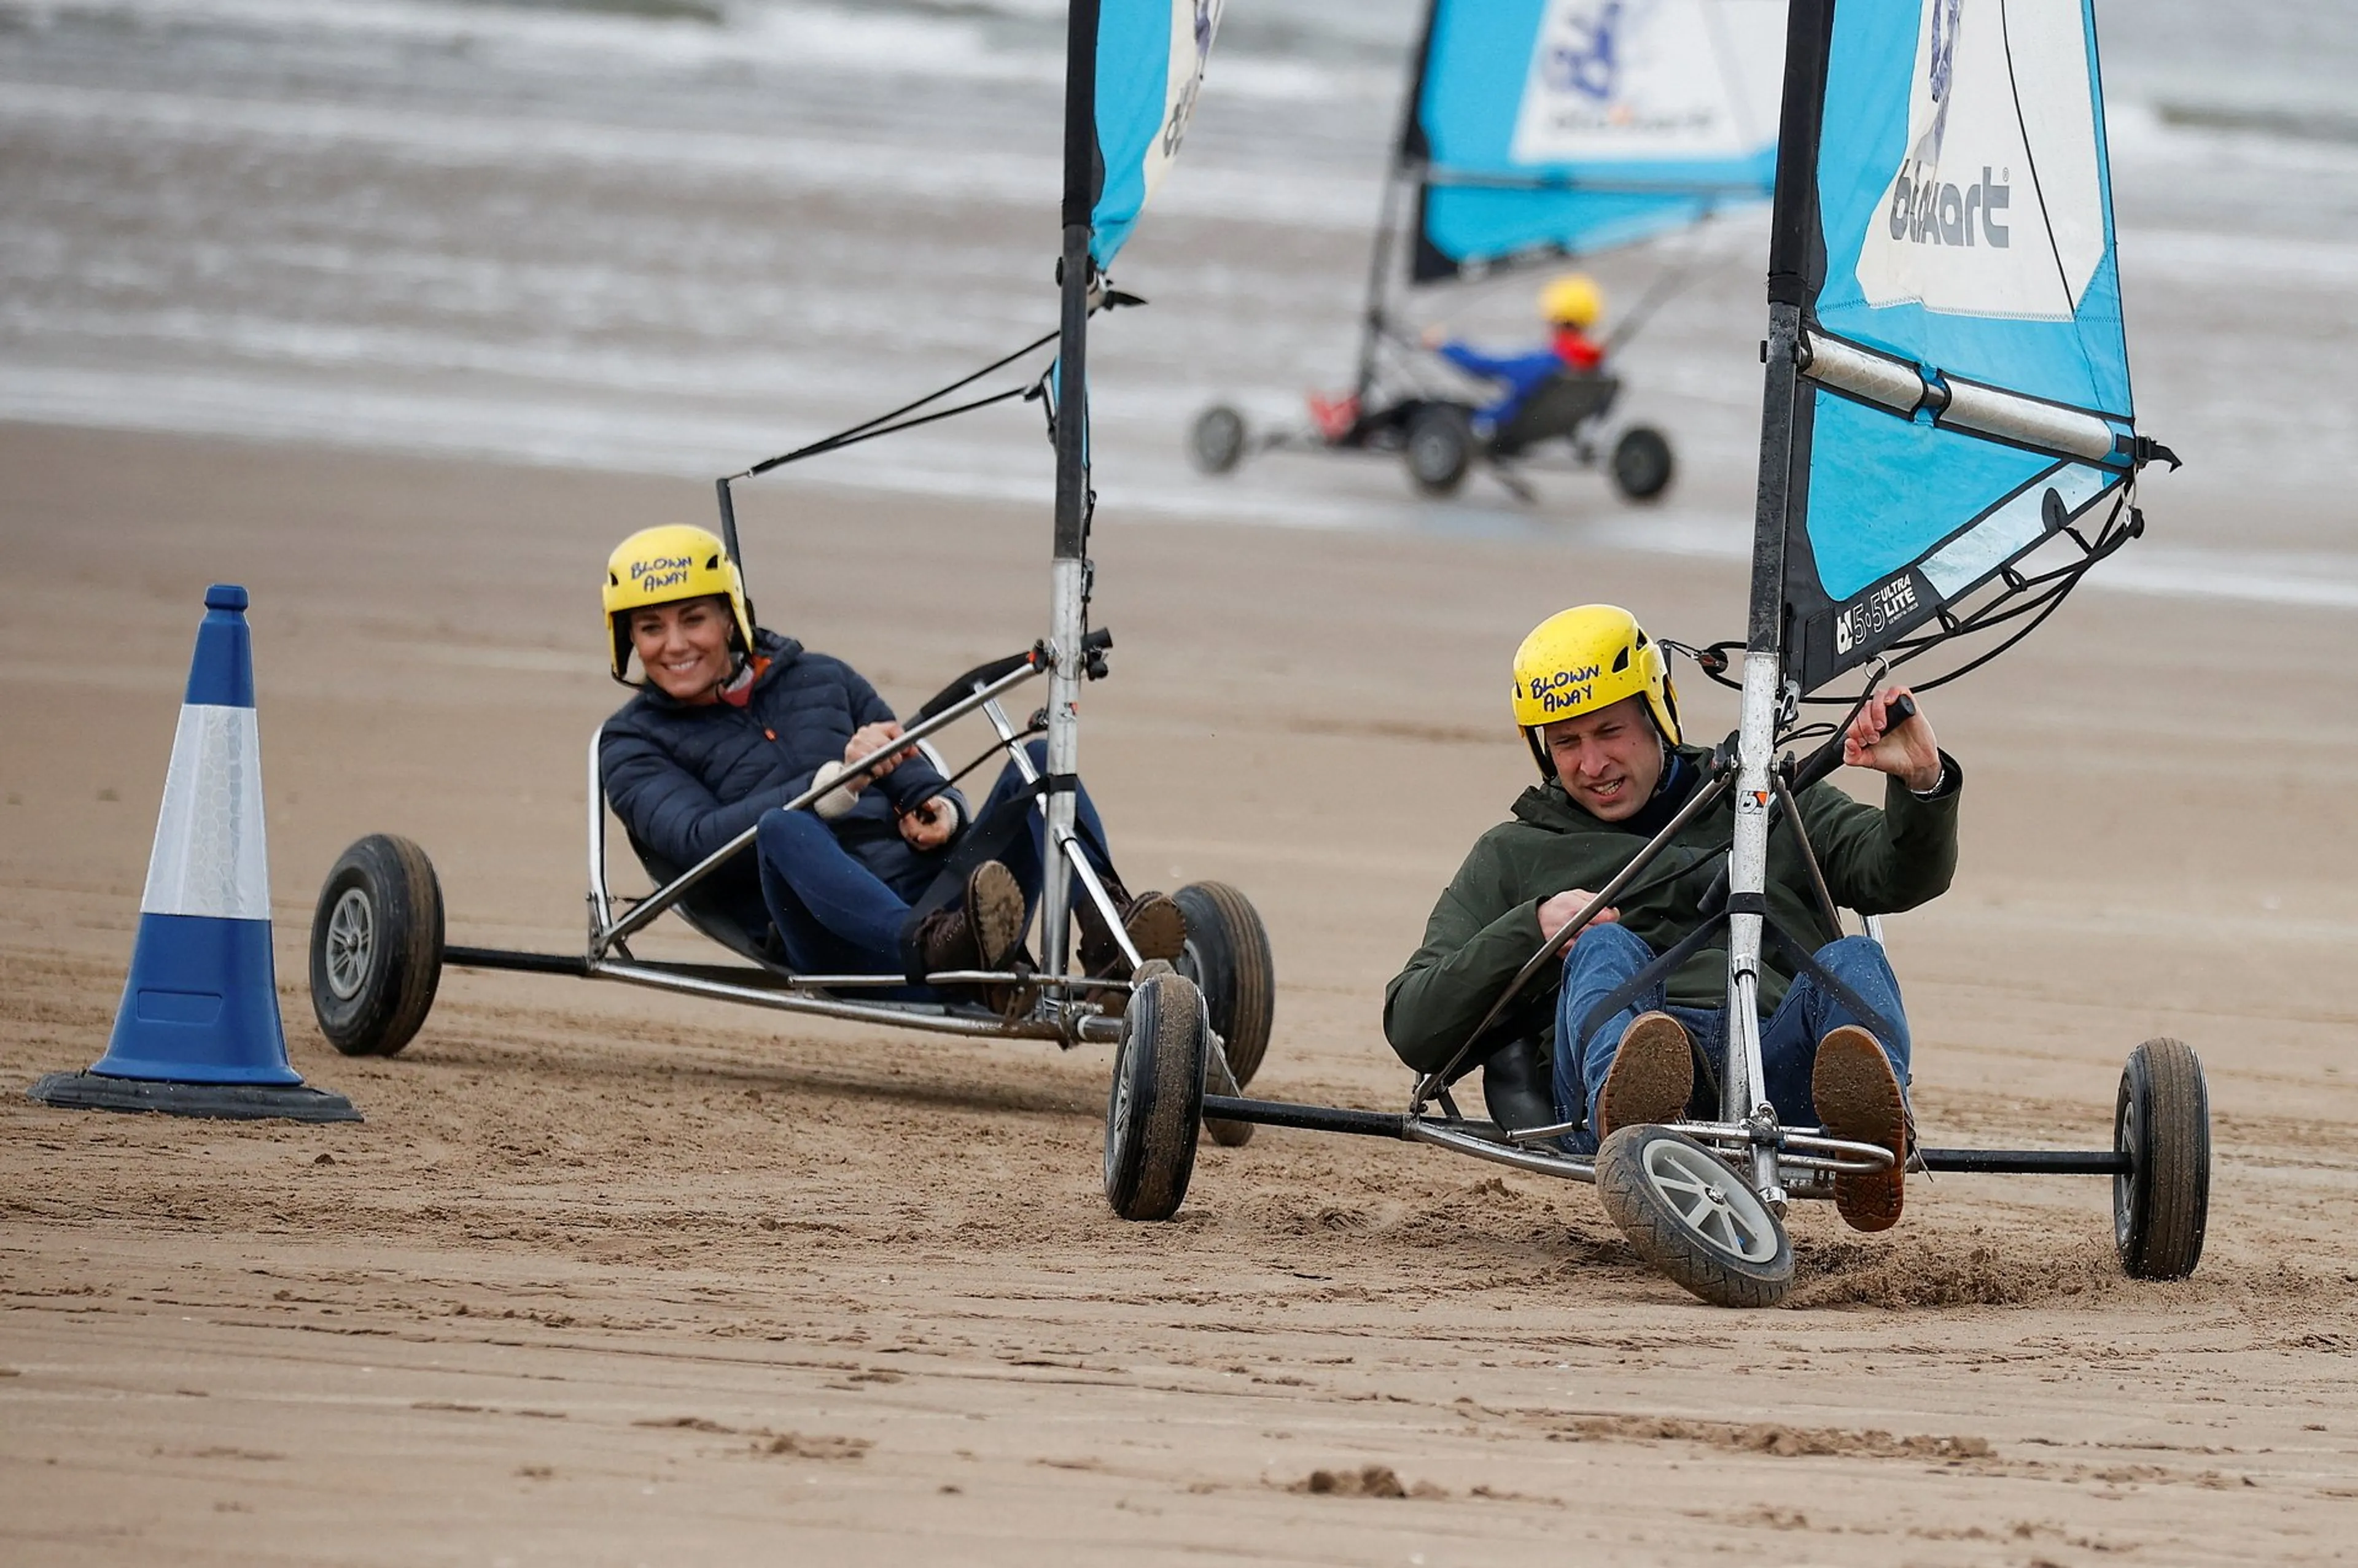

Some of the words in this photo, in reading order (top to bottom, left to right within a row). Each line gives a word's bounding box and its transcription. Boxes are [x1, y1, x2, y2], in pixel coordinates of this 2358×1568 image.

[630, 556, 693, 580] BLOWN
[643, 570, 688, 592] AWAY
[1880, 573, 1912, 602] ULTRA
[1883, 586, 1916, 618] LITE
[1530, 664, 1600, 699] BLOWN
[1543, 685, 1593, 712] AWAY
